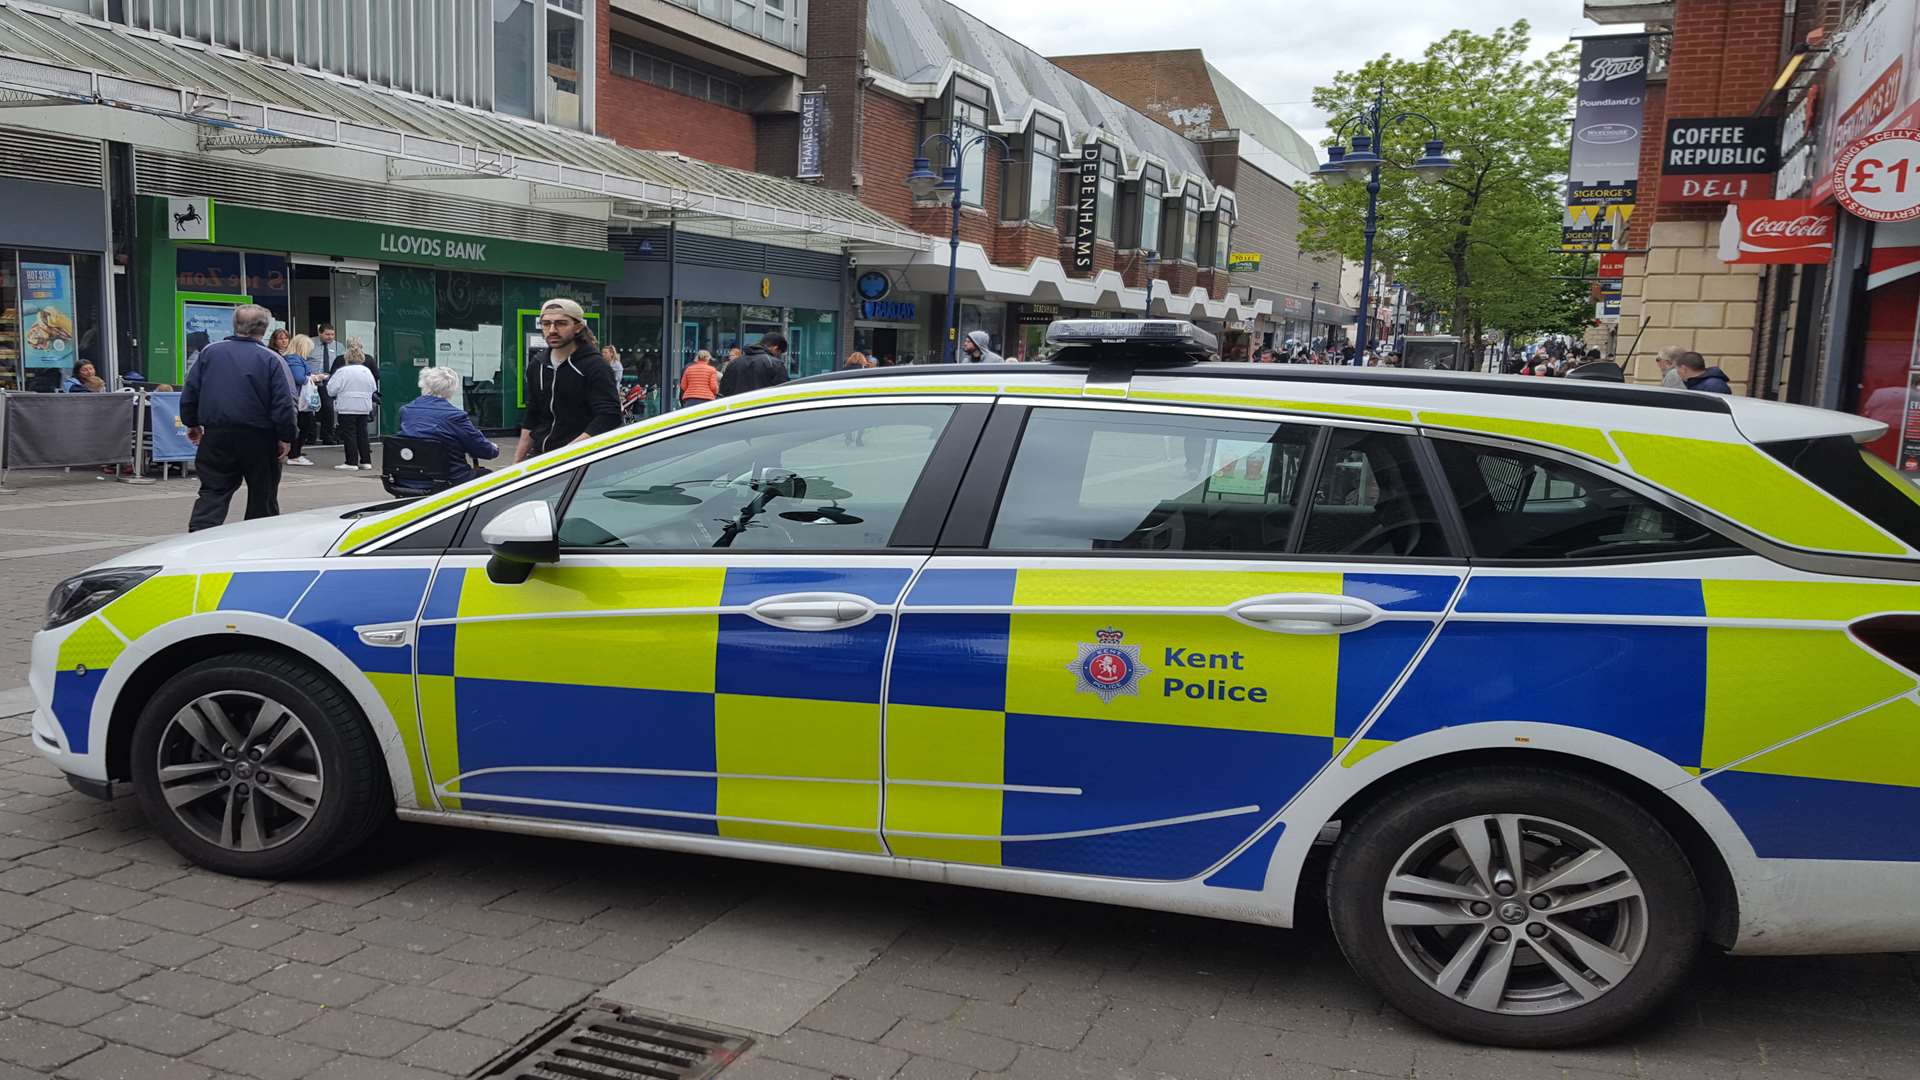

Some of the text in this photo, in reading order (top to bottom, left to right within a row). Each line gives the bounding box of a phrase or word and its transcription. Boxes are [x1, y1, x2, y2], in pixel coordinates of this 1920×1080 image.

[1582, 56, 1644, 82] Boots
[1580, 98, 1628, 107] Poundland
[802, 97, 814, 173] THAMESGATE
[1673, 127, 1744, 145] COFFEE
[1670, 147, 1766, 166] REPUBLIC
[1834, 139, 1869, 201] EVERYTHING'S
[1682, 179, 1748, 198] DELI
[1077, 149, 1098, 267] DEBENHAMS
[1747, 216, 1832, 238] Coca-Cola
[380, 232, 487, 261] LLOYDS BANK
[1164, 647, 1244, 670] Kent
[1163, 678, 1267, 703] Police
